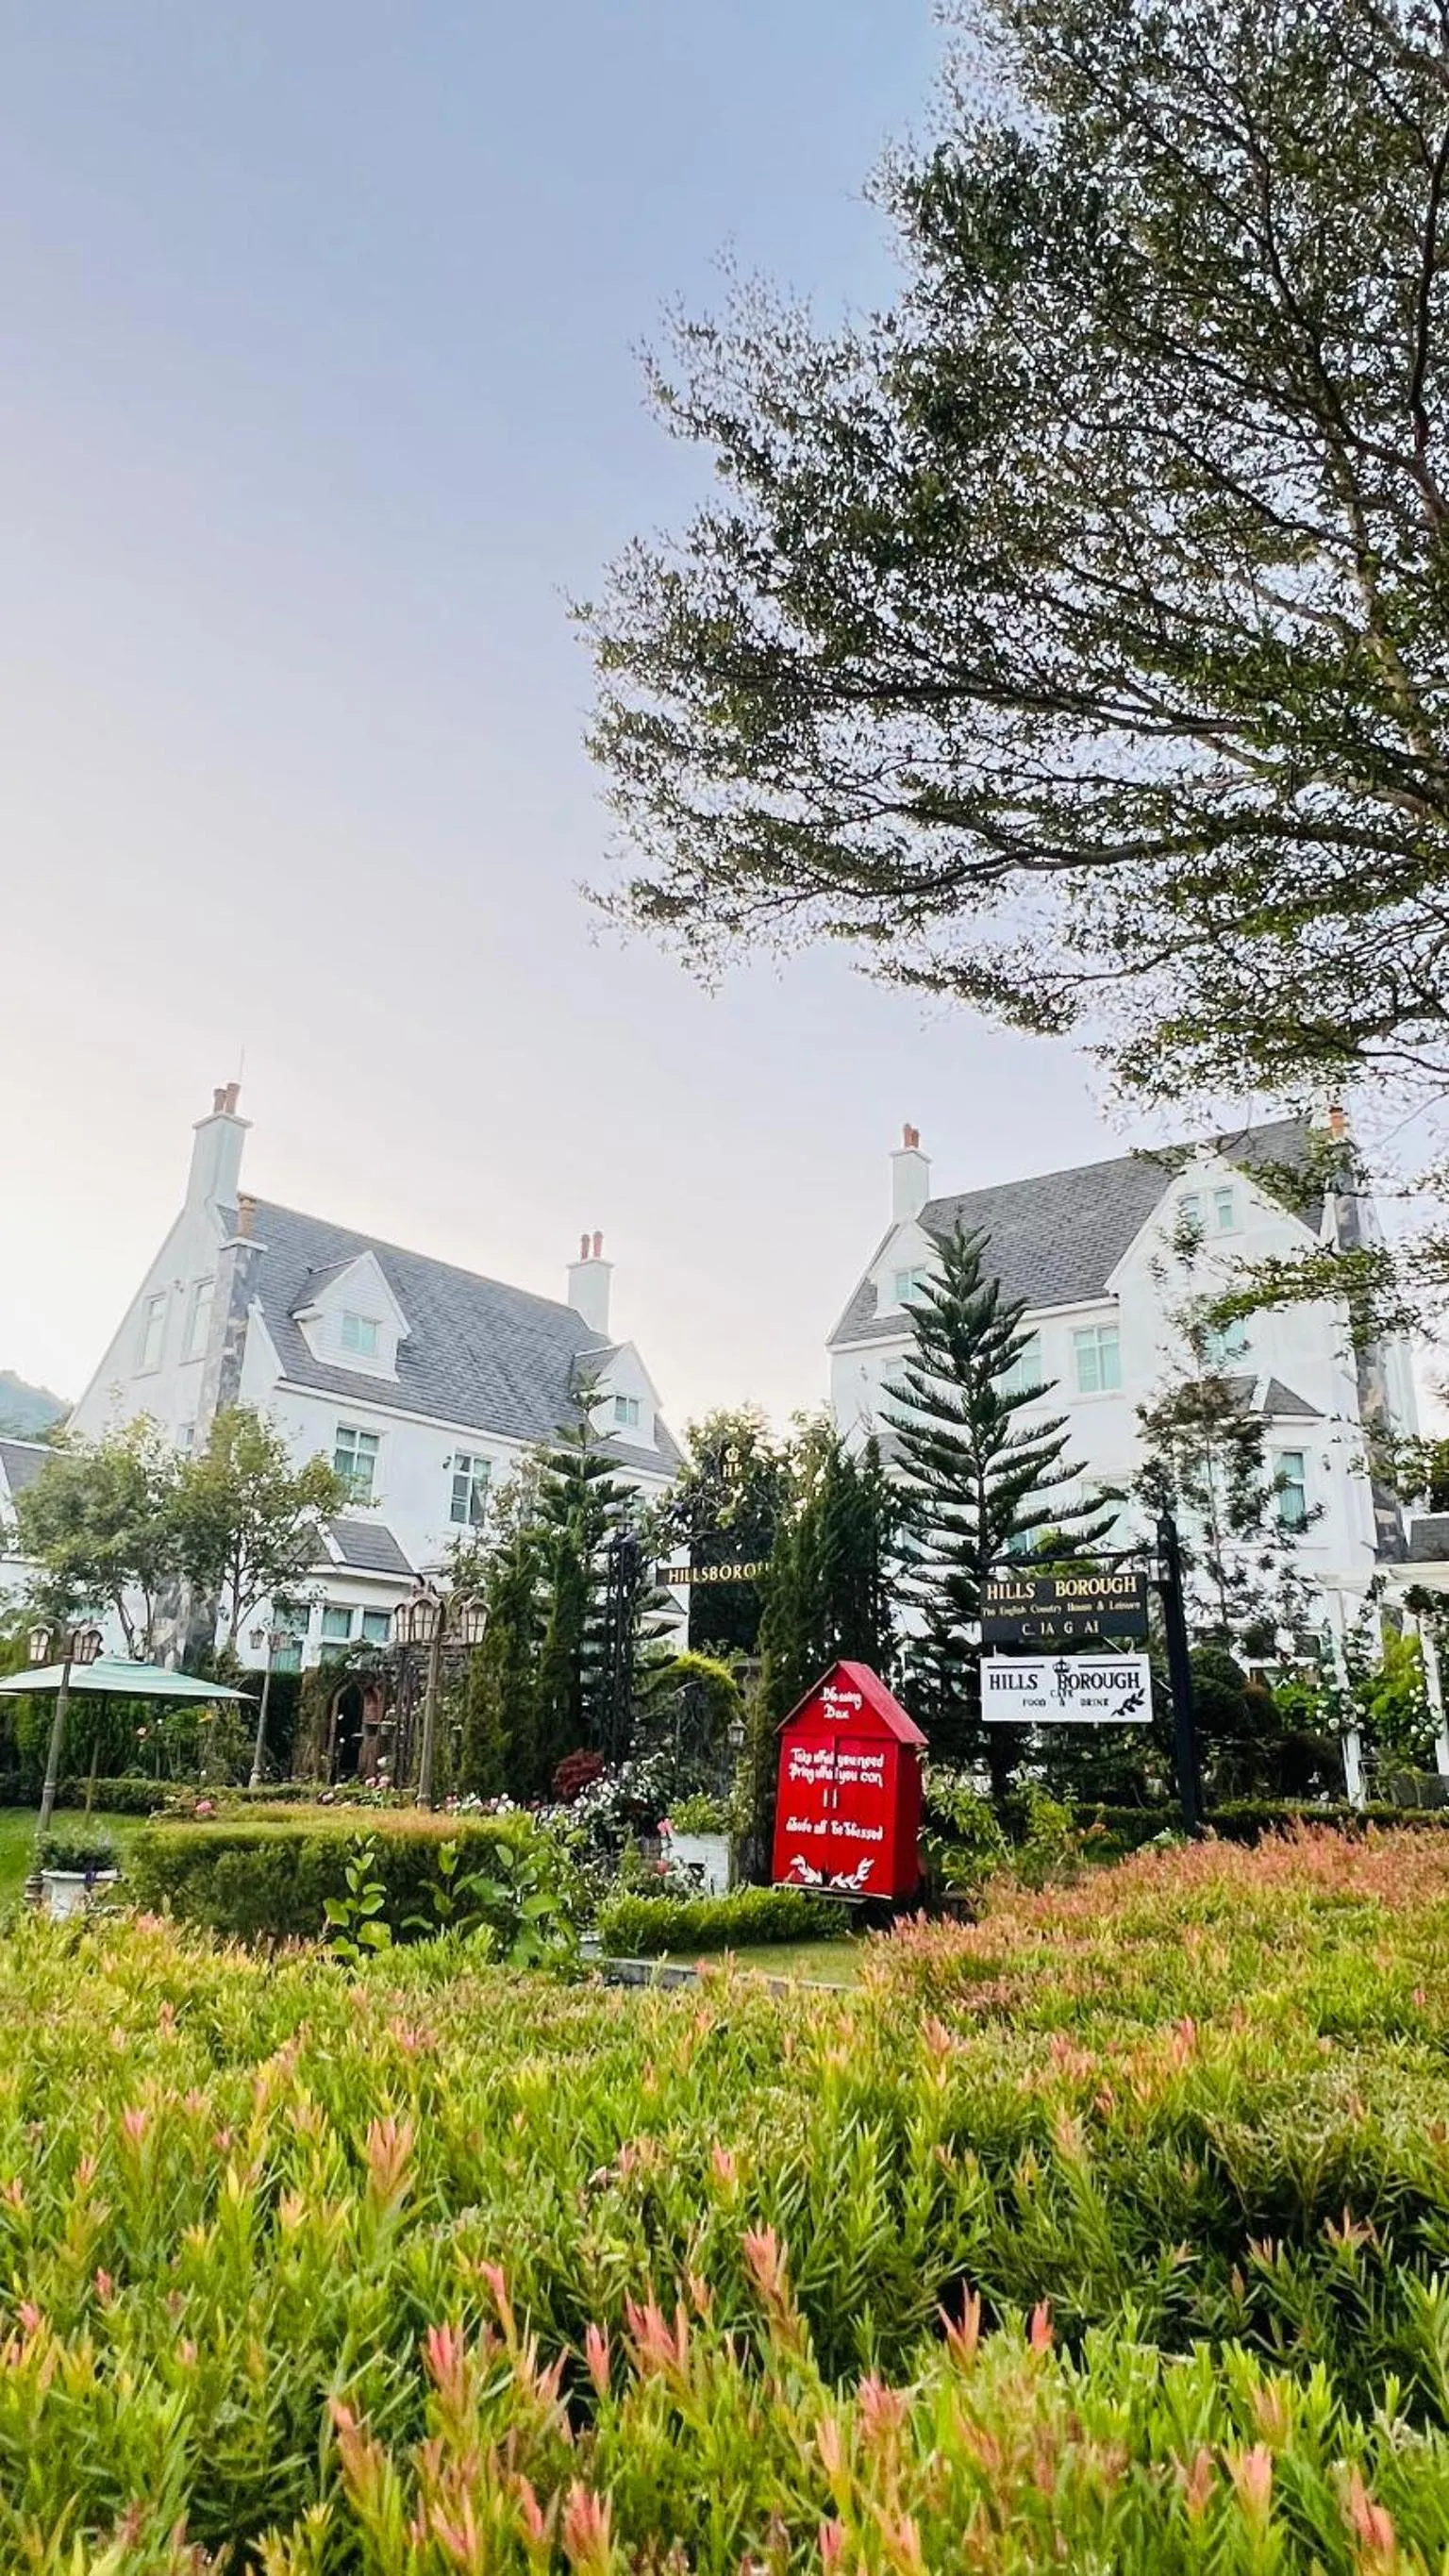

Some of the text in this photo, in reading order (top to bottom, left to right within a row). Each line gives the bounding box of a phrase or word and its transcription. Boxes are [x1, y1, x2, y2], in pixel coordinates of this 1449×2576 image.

[987, 1576, 1138, 1600] HILLS BOROUGH
[982, 1607, 996, 1616] The
[999, 1605, 1027, 1616] English
[1030, 1604, 1062, 1615] Country
[1096, 1600, 1104, 1611] &
[990, 1672, 1141, 1690] HILLS BOROUGH
[1023, 1698, 1046, 1707] FOOD
[1080, 1698, 1109, 1707] DRINK
[839, 1769, 858, 1784] you
[860, 1771, 883, 1788] can
